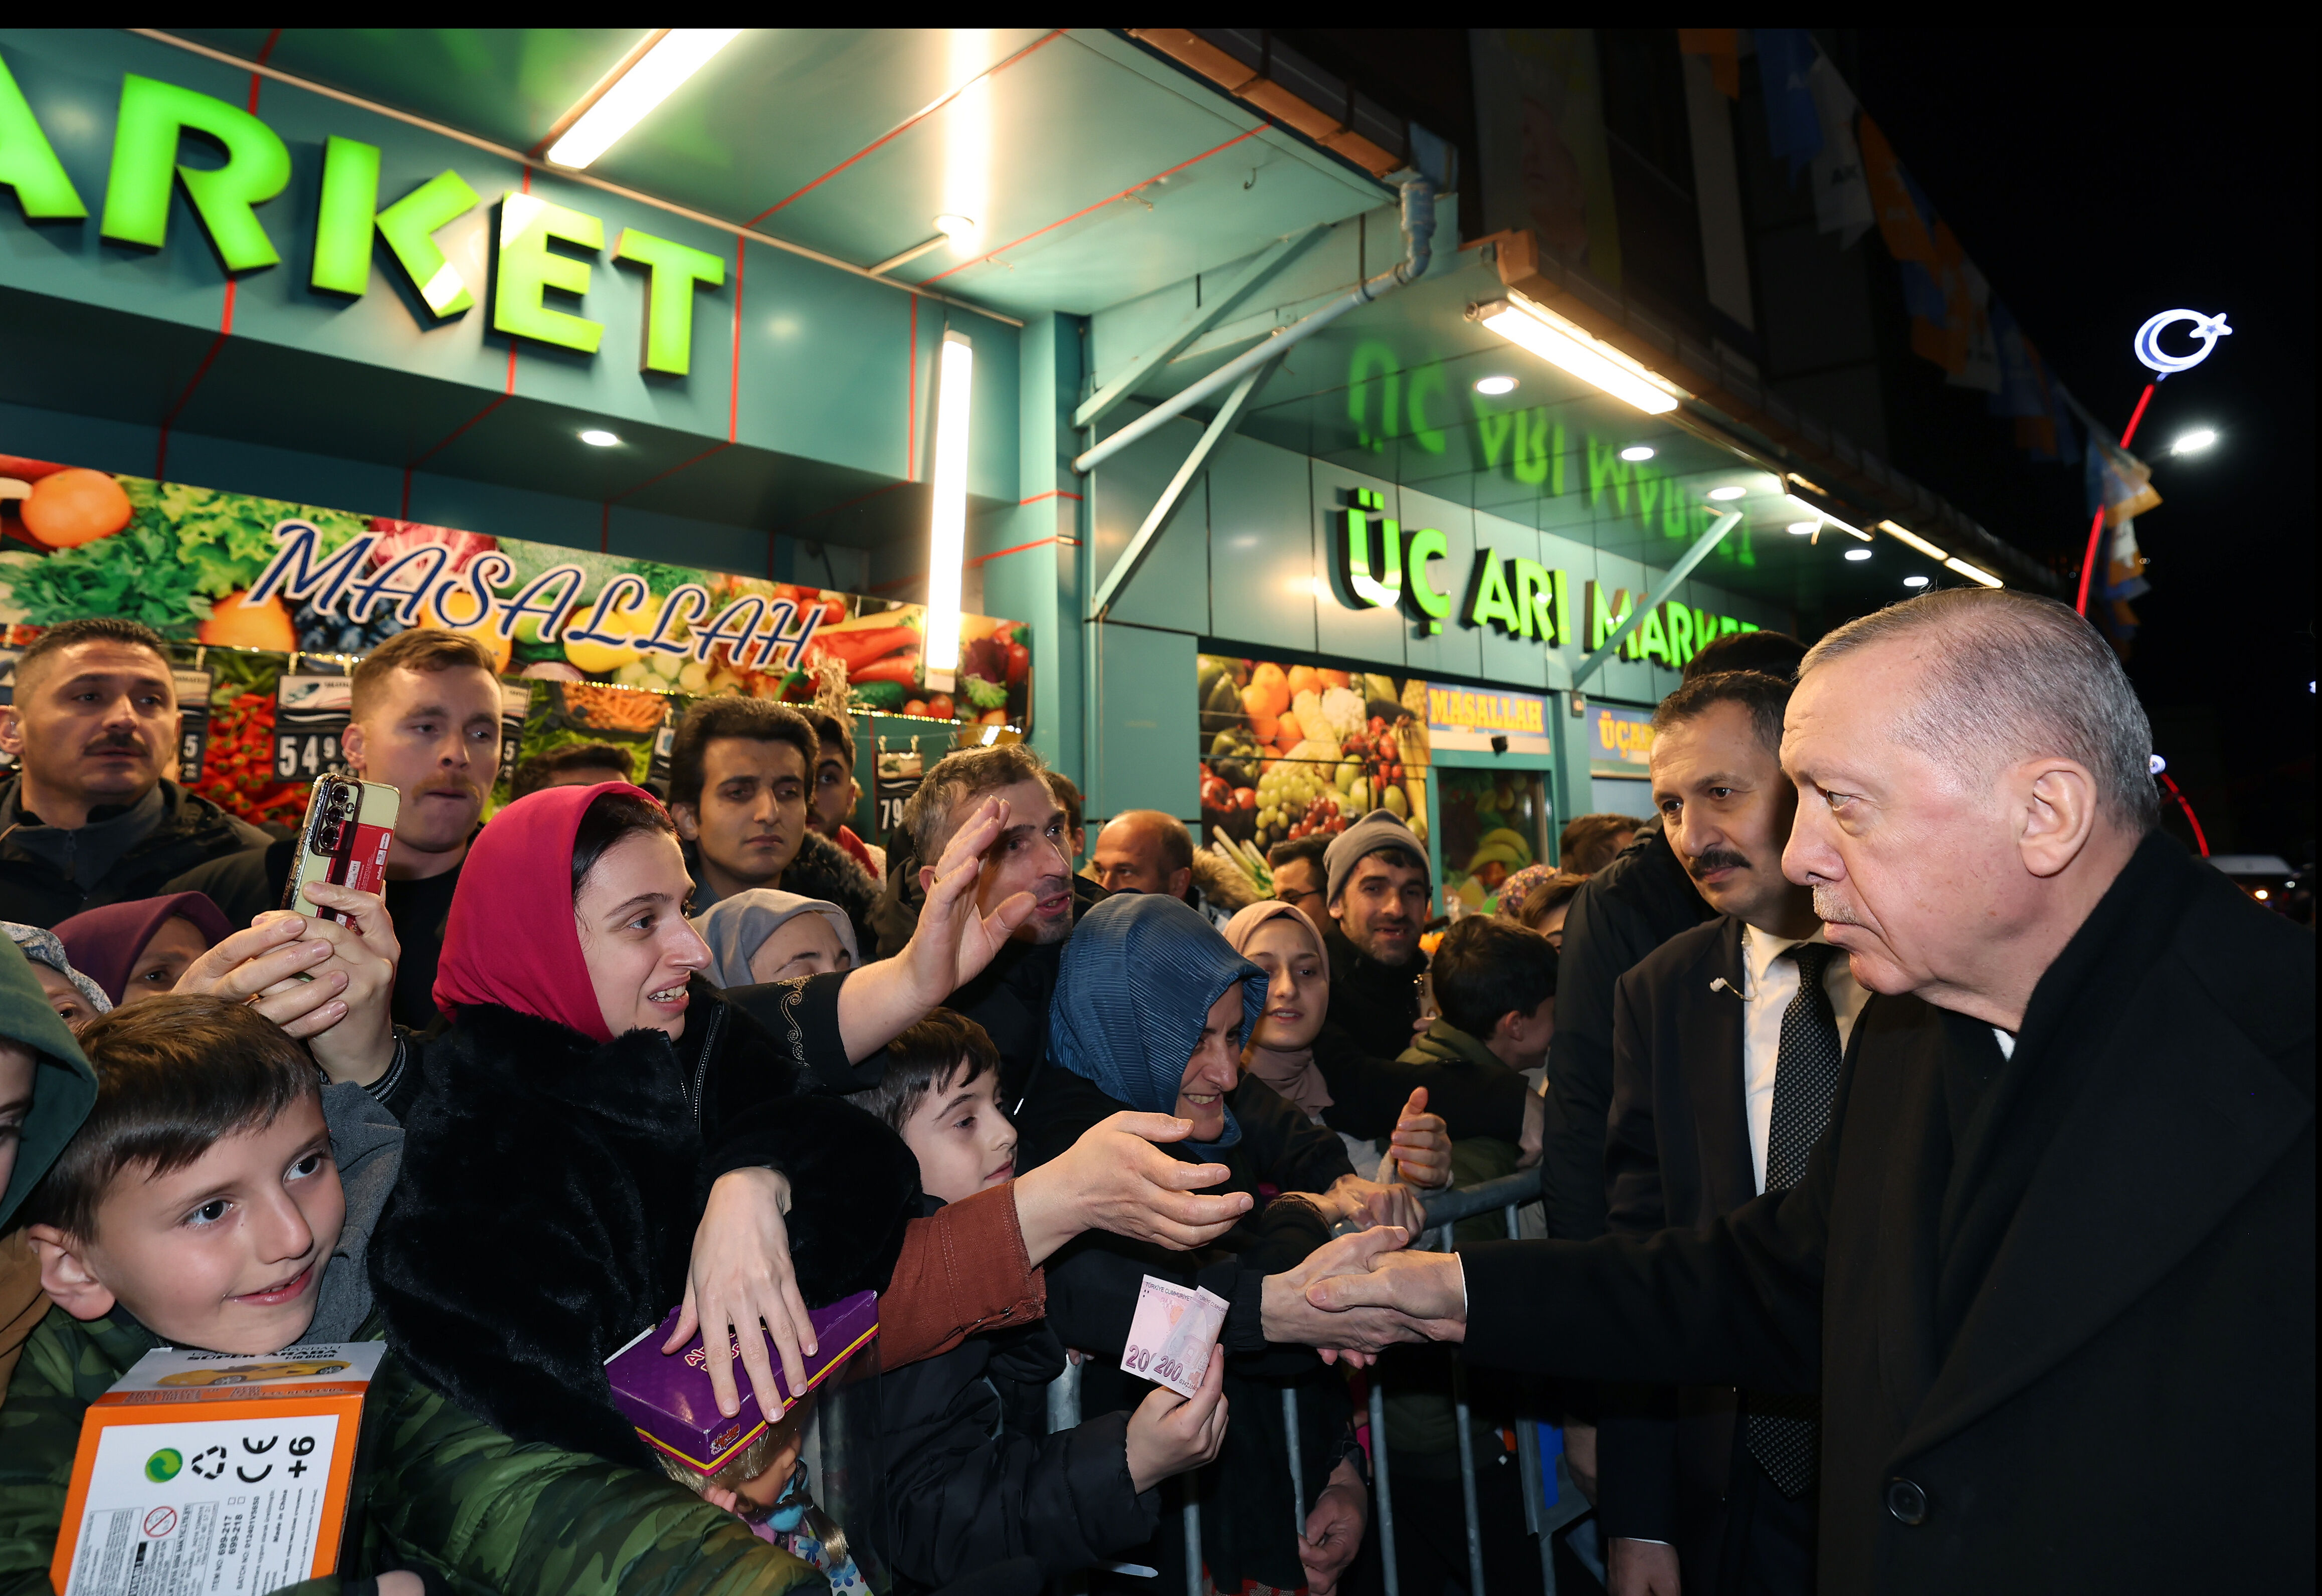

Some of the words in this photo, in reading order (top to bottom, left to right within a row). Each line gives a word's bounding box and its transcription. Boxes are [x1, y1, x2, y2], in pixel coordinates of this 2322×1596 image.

[1347, 487, 1450, 636] ÜÇ
[1472, 546, 1572, 645] ARI
[1428, 688, 1544, 734] MAŞALLAH
[1145, 1281, 1165, 1293] TÜRKİYE
[1153, 1355, 1184, 1381] 200
[288, 1436, 315, 1479] +6
[218, 1515, 232, 1555] 699-217
[228, 1513, 244, 1555] 699-218
[273, 1522, 283, 1543] Made
[279, 1489, 288, 1511] China
